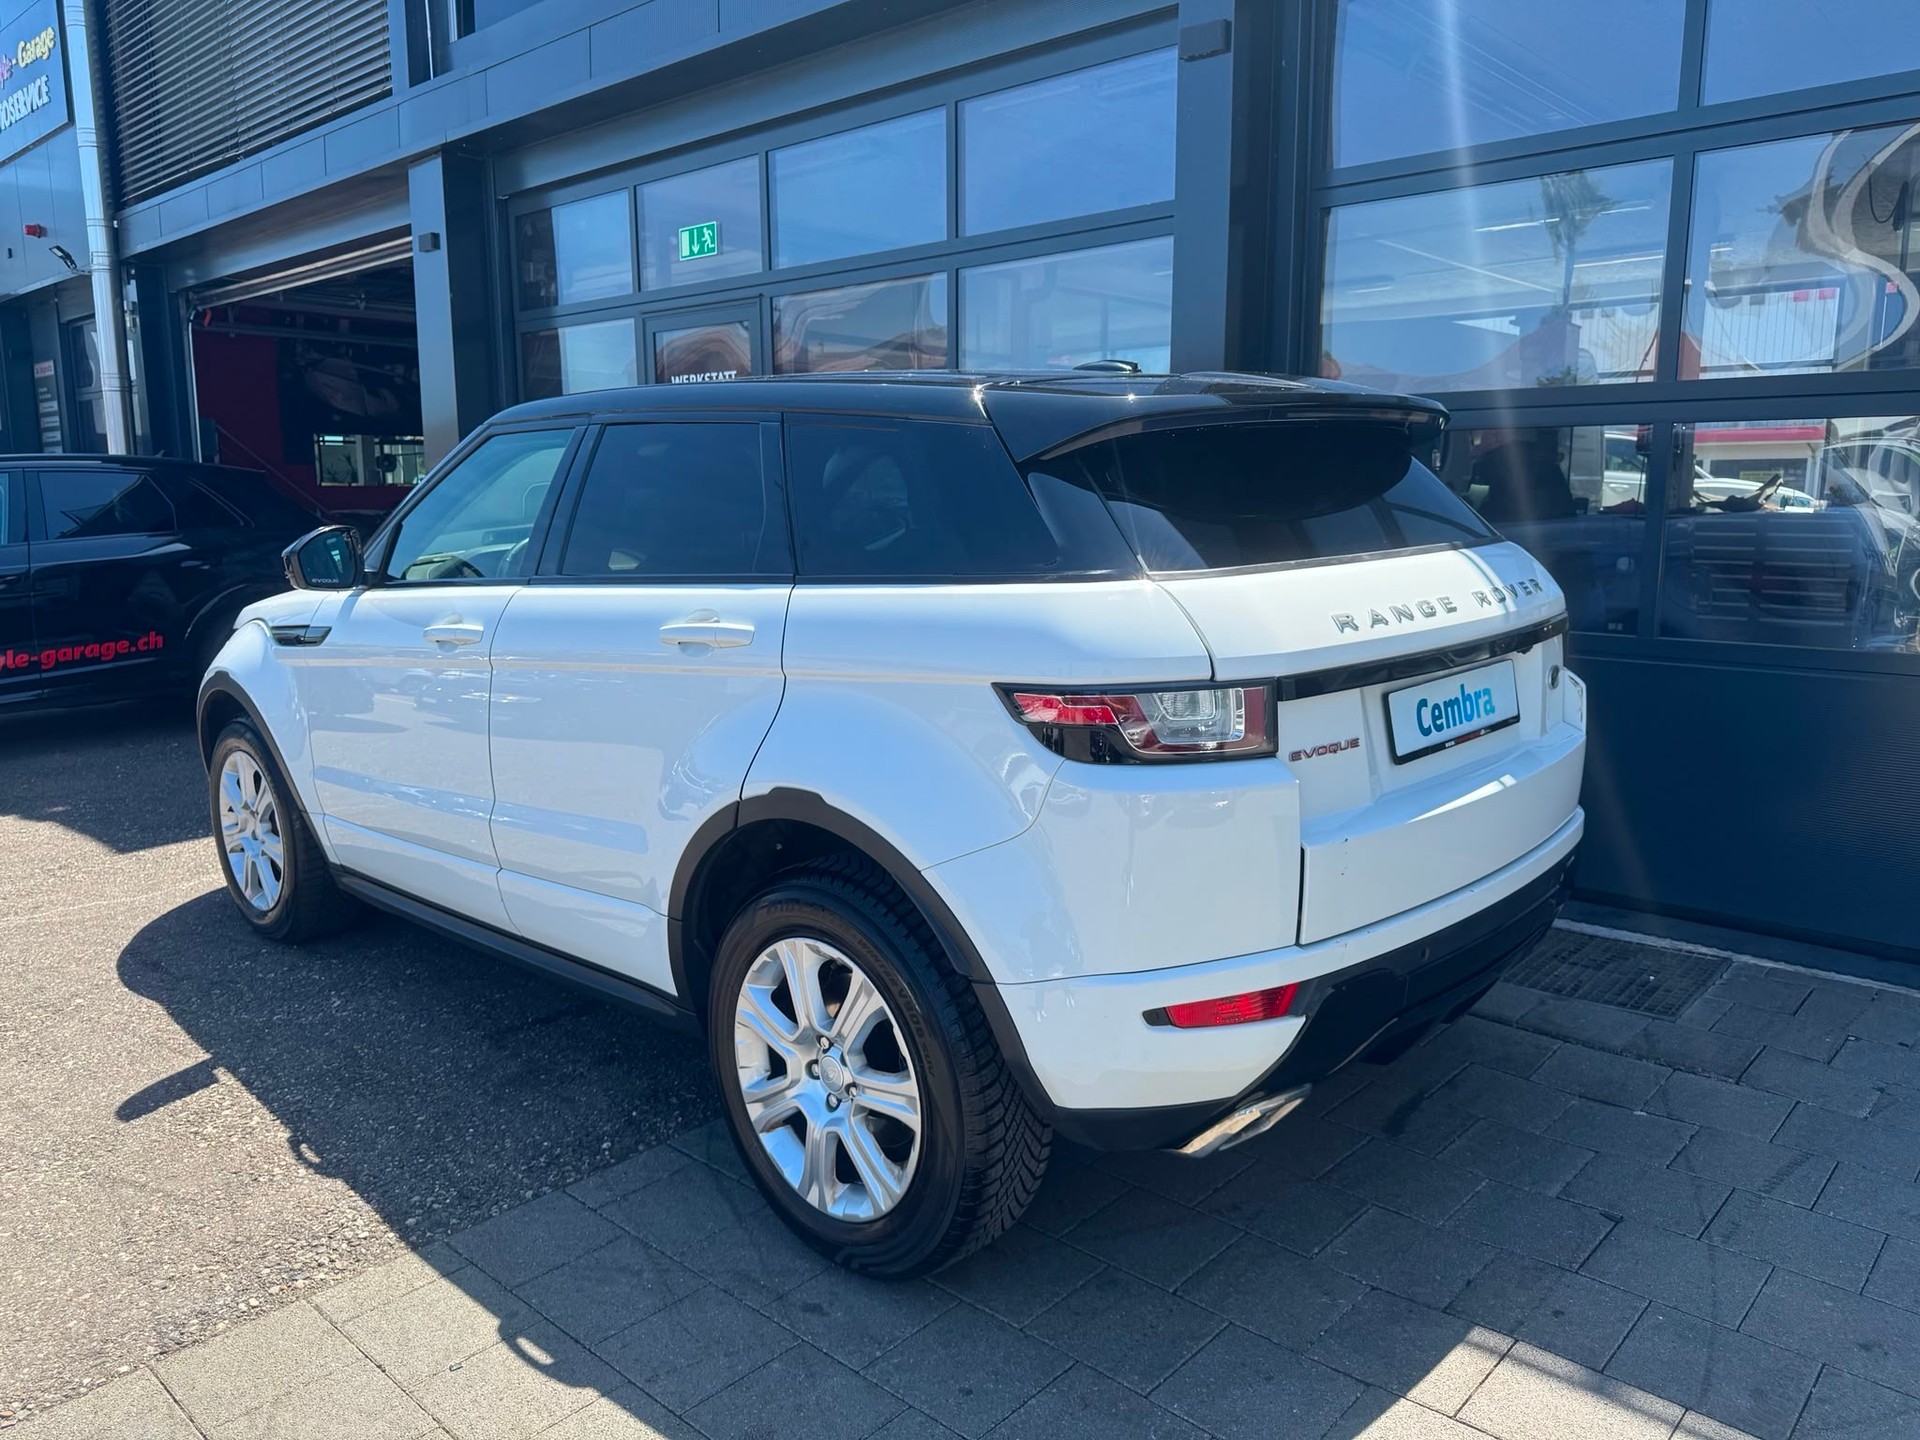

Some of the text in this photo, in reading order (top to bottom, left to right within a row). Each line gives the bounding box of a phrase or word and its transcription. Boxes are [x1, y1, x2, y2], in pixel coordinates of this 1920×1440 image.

[1331, 578, 1543, 633] RANGE ROVER
[1416, 683, 1496, 737] Cembra
[1289, 738, 1360, 761] EVOQUE
